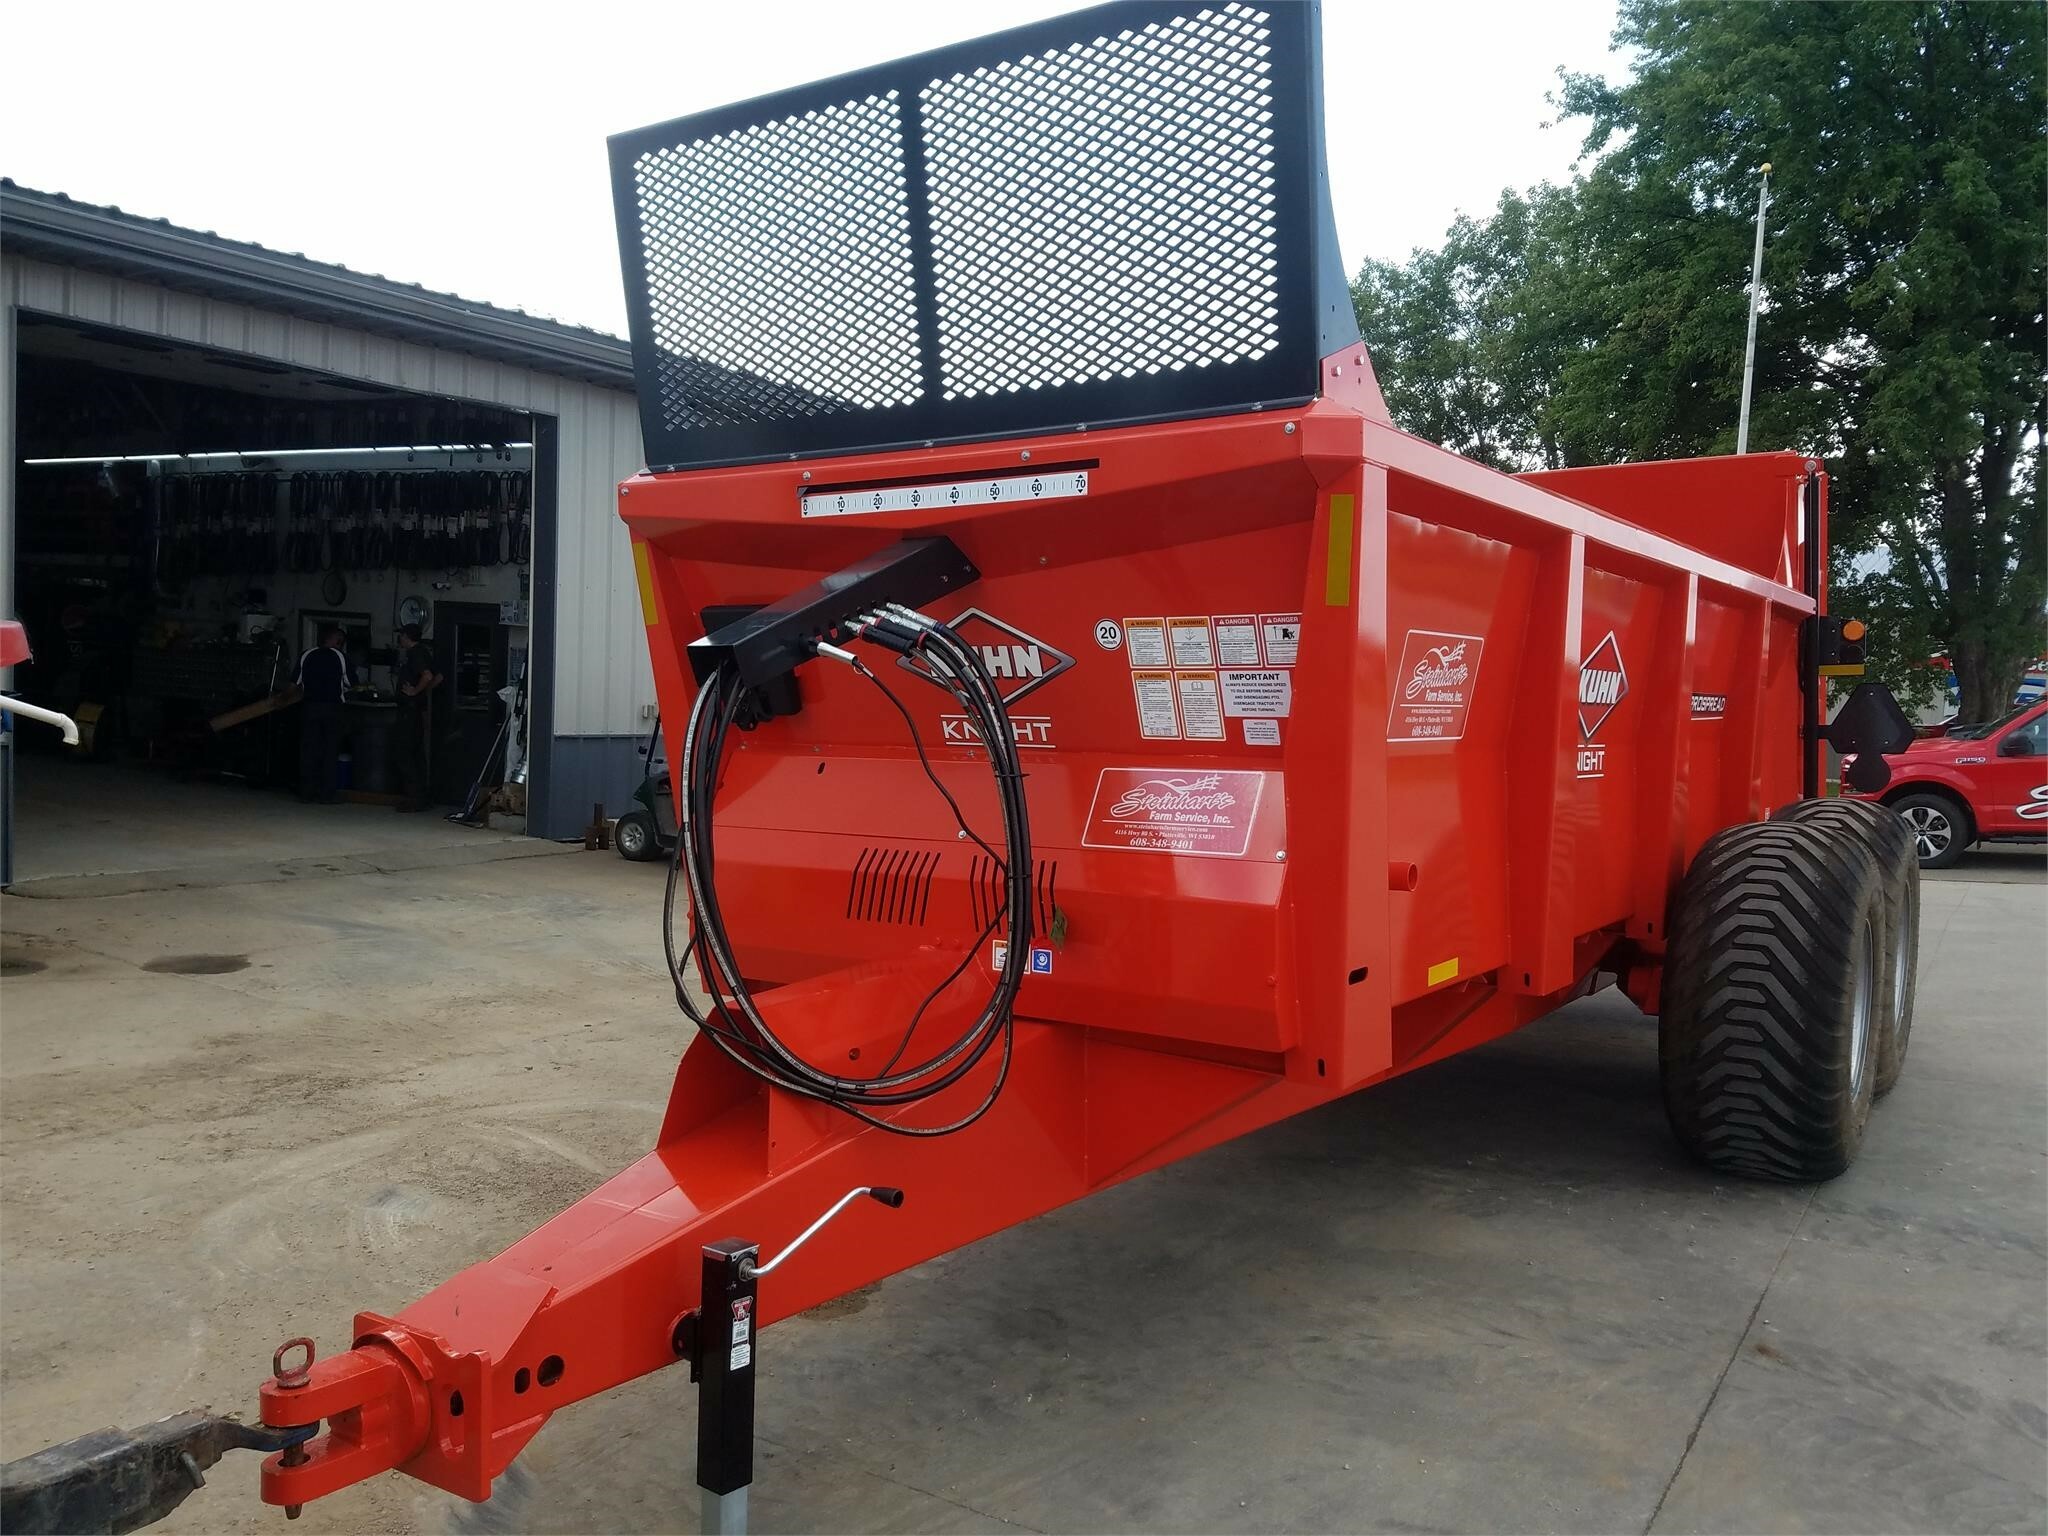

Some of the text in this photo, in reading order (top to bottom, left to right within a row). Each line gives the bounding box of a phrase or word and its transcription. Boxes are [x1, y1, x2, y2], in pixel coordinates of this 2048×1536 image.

[803, 480, 1086, 512] 0 10 20 30 40 50 60 70
[1100, 626, 1116, 639] 20
[1579, 669, 1622, 704] KUHN
[942, 720, 1052, 742] KNHT
[1149, 811, 1230, 823] Farm Service, Inc.
[1130, 838, 1193, 849] 608-348-9401
